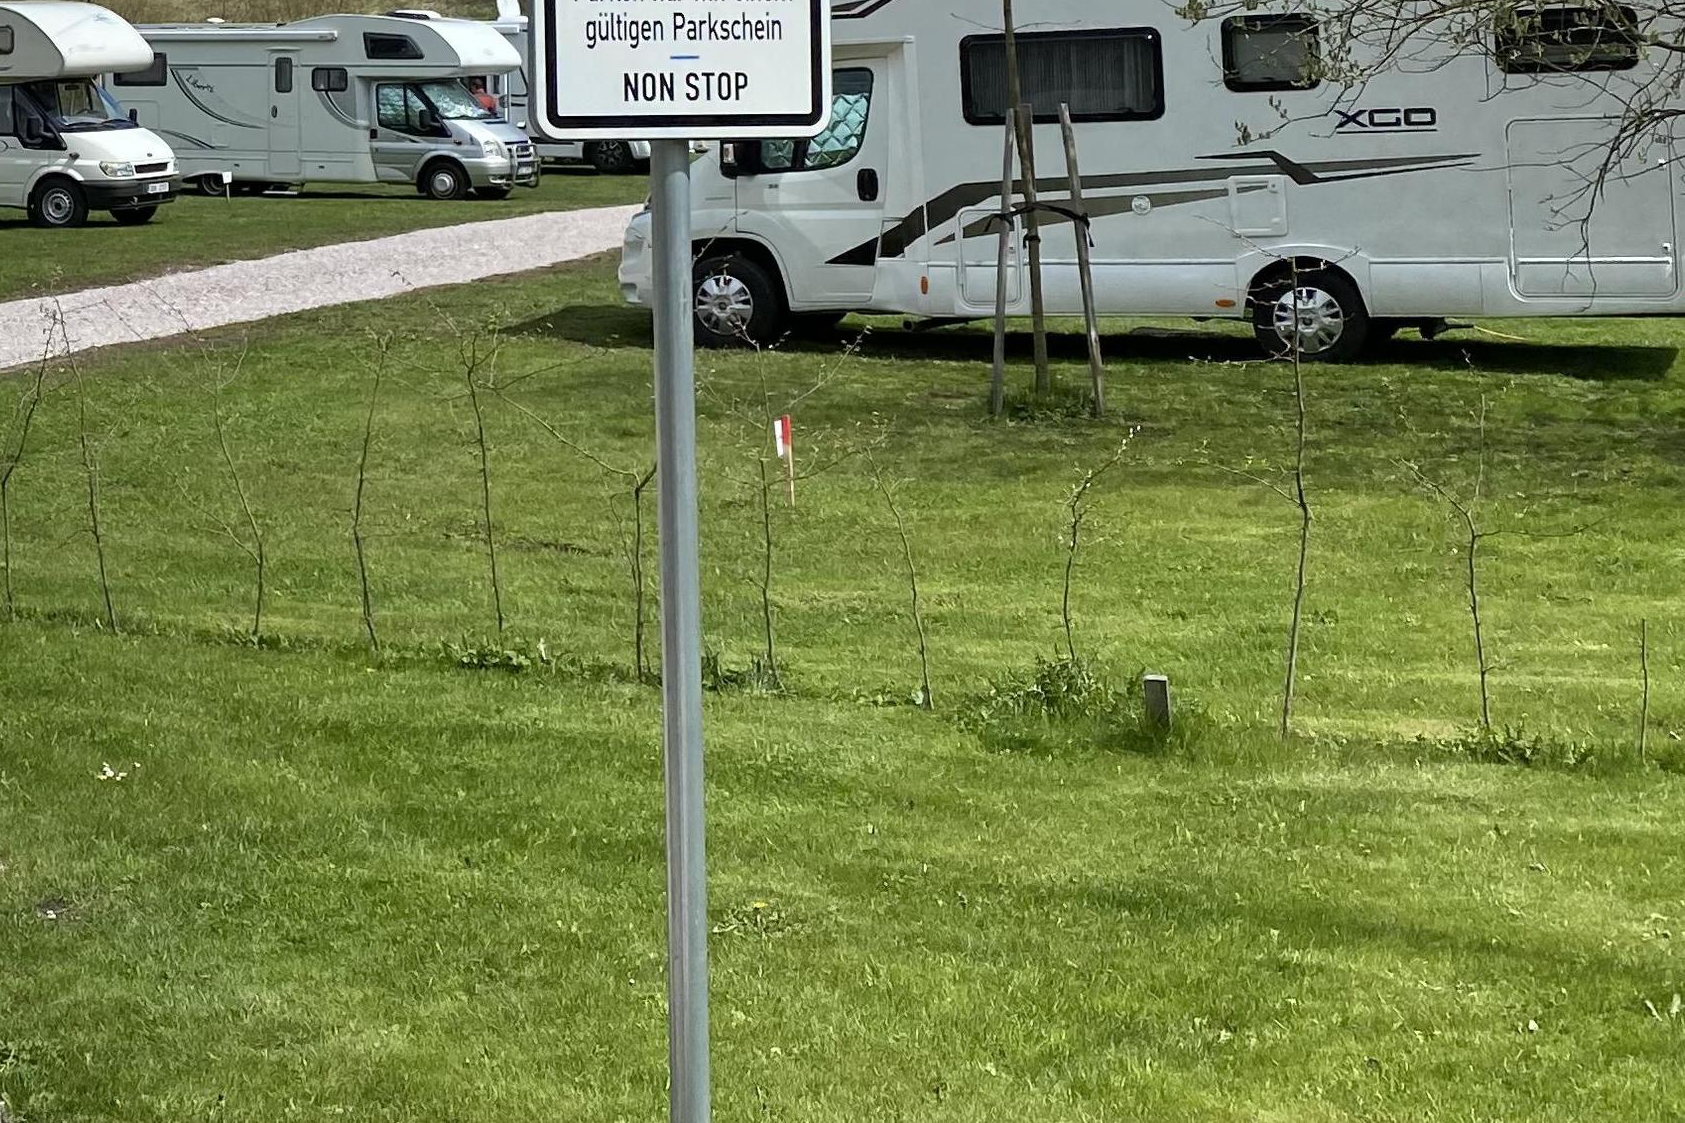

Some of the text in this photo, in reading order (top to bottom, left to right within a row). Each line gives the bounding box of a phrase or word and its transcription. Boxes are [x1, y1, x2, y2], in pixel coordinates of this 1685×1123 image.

[585, 11, 782, 50] gültigen Parkschein
[623, 71, 748, 102] NON STOP
[1334, 108, 1436, 128] XGO
